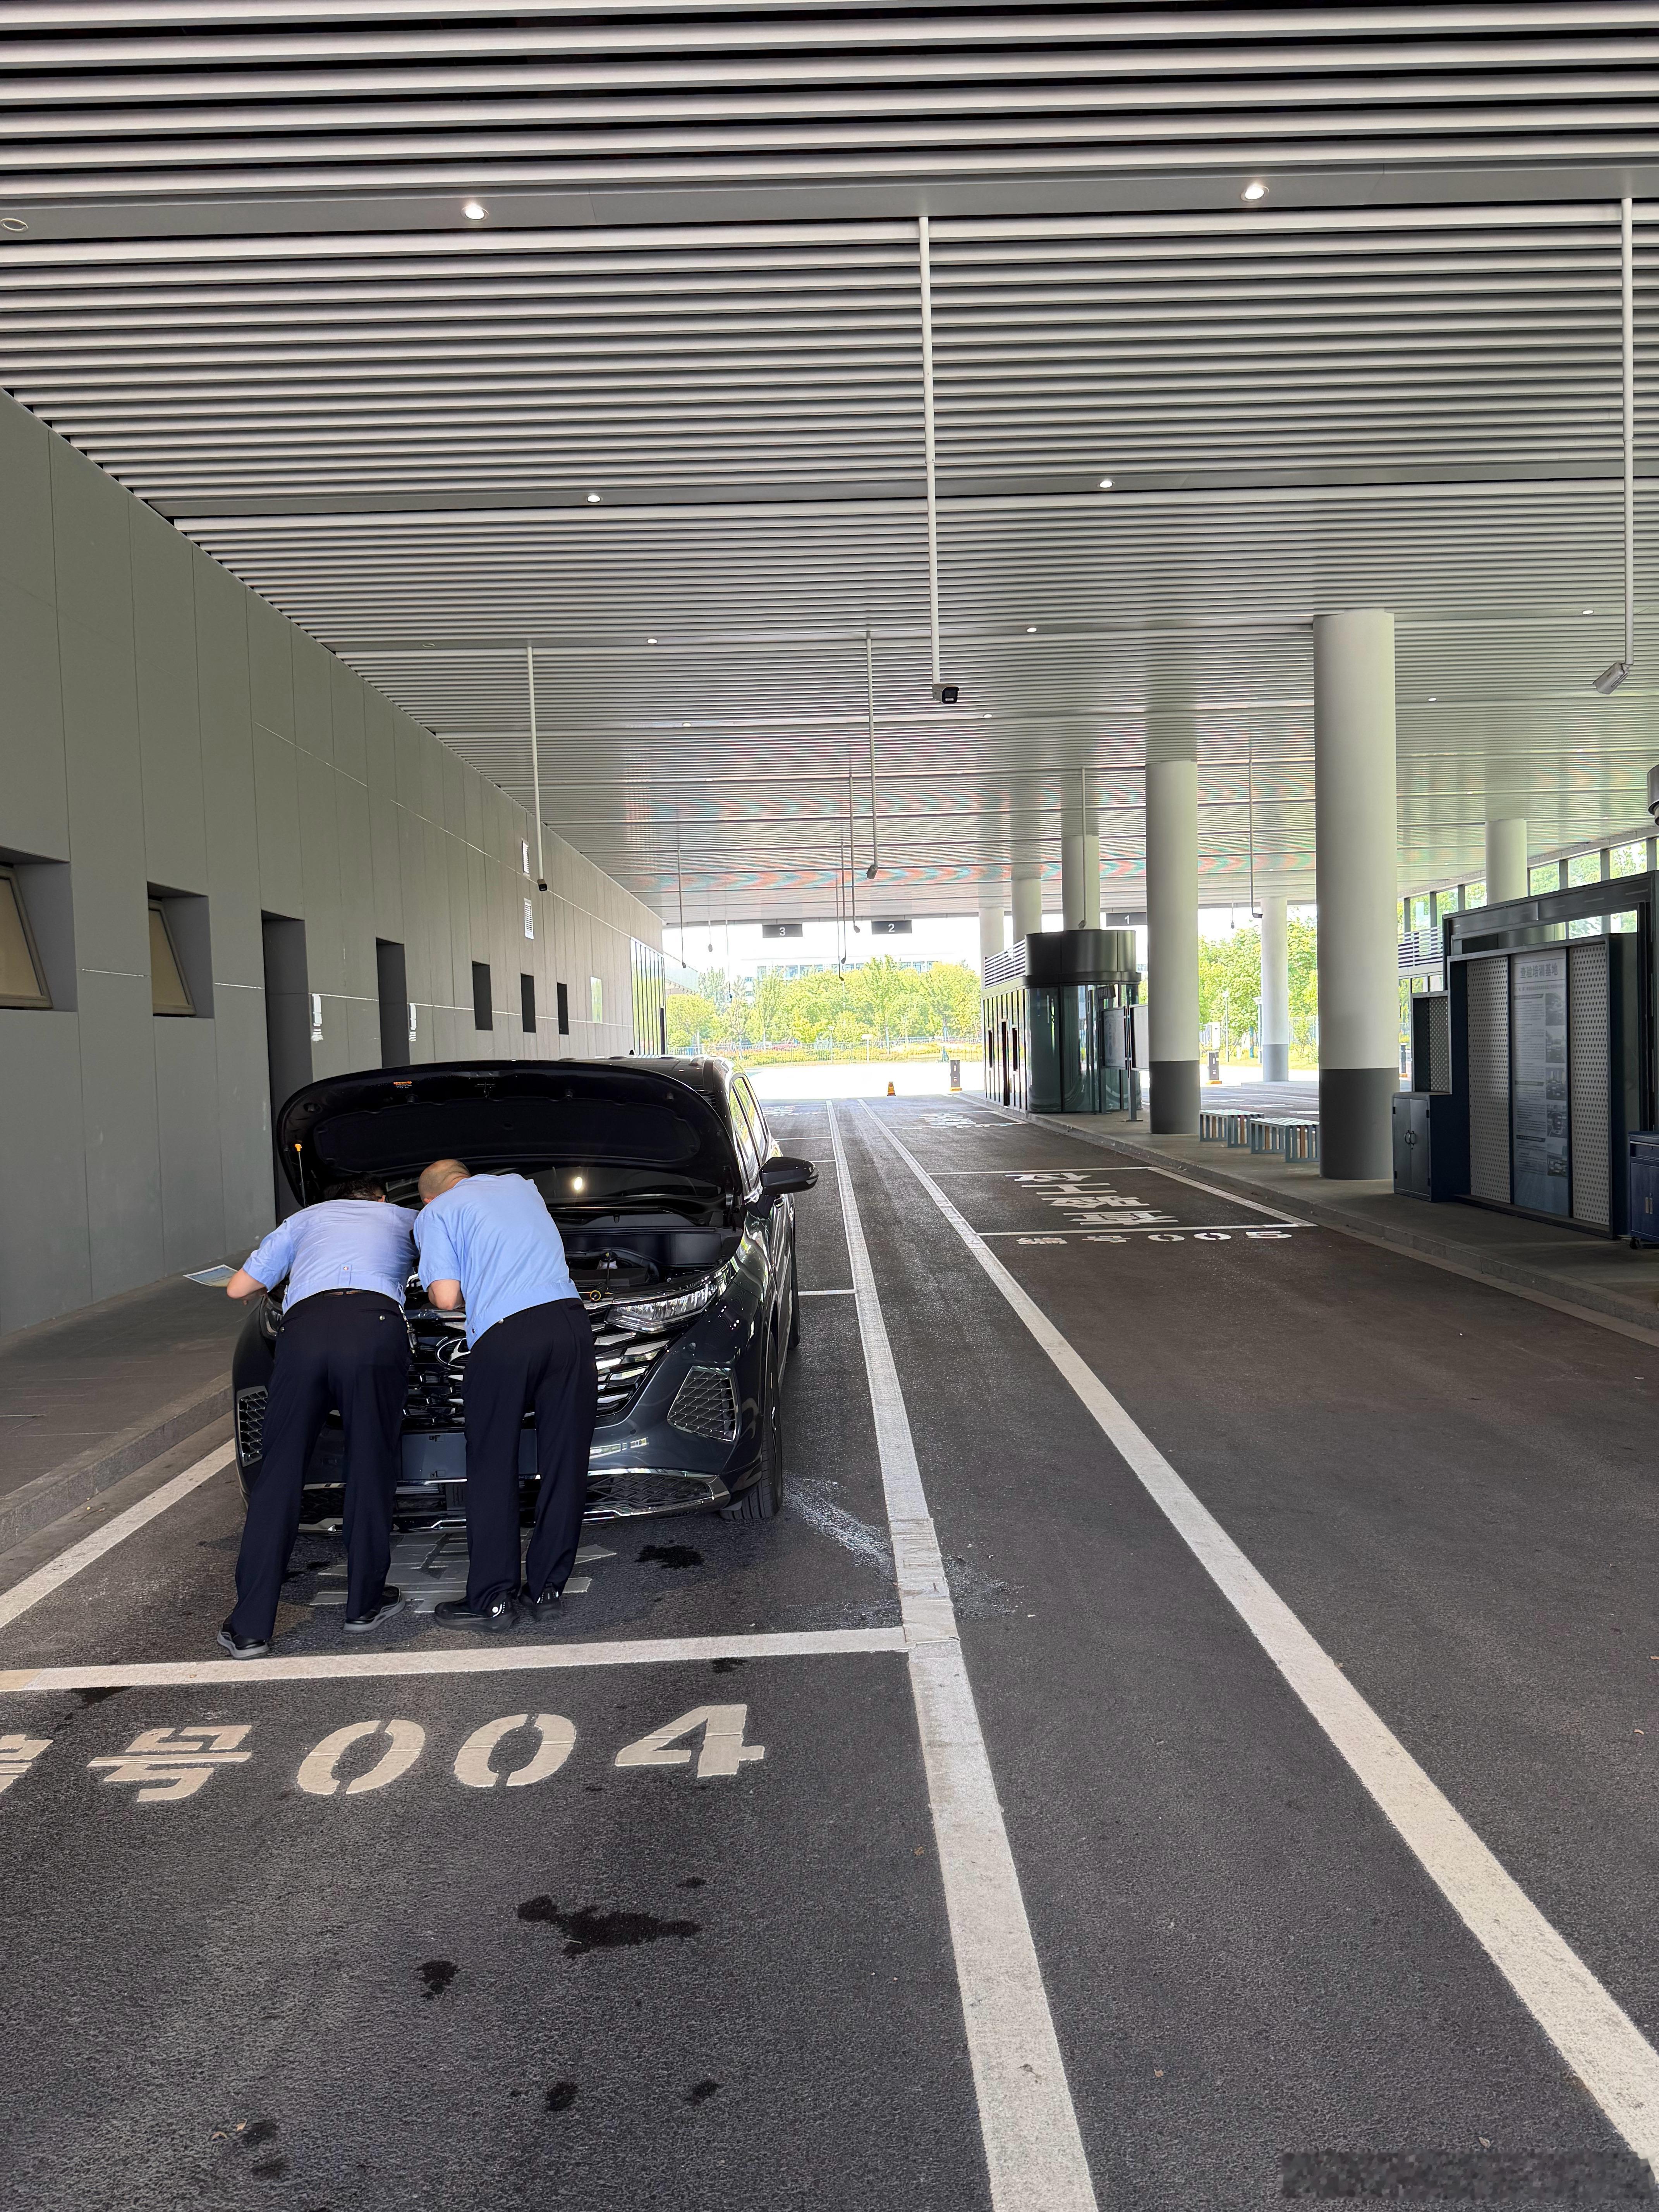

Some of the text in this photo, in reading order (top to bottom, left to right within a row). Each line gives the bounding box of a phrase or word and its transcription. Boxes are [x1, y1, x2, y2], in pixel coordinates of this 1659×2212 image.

[1124, 915, 1130, 924] 1
[779, 927, 786, 936] 3
[888, 924, 895, 933] 2
[1520, 963, 1558, 978] 查验培训基地
